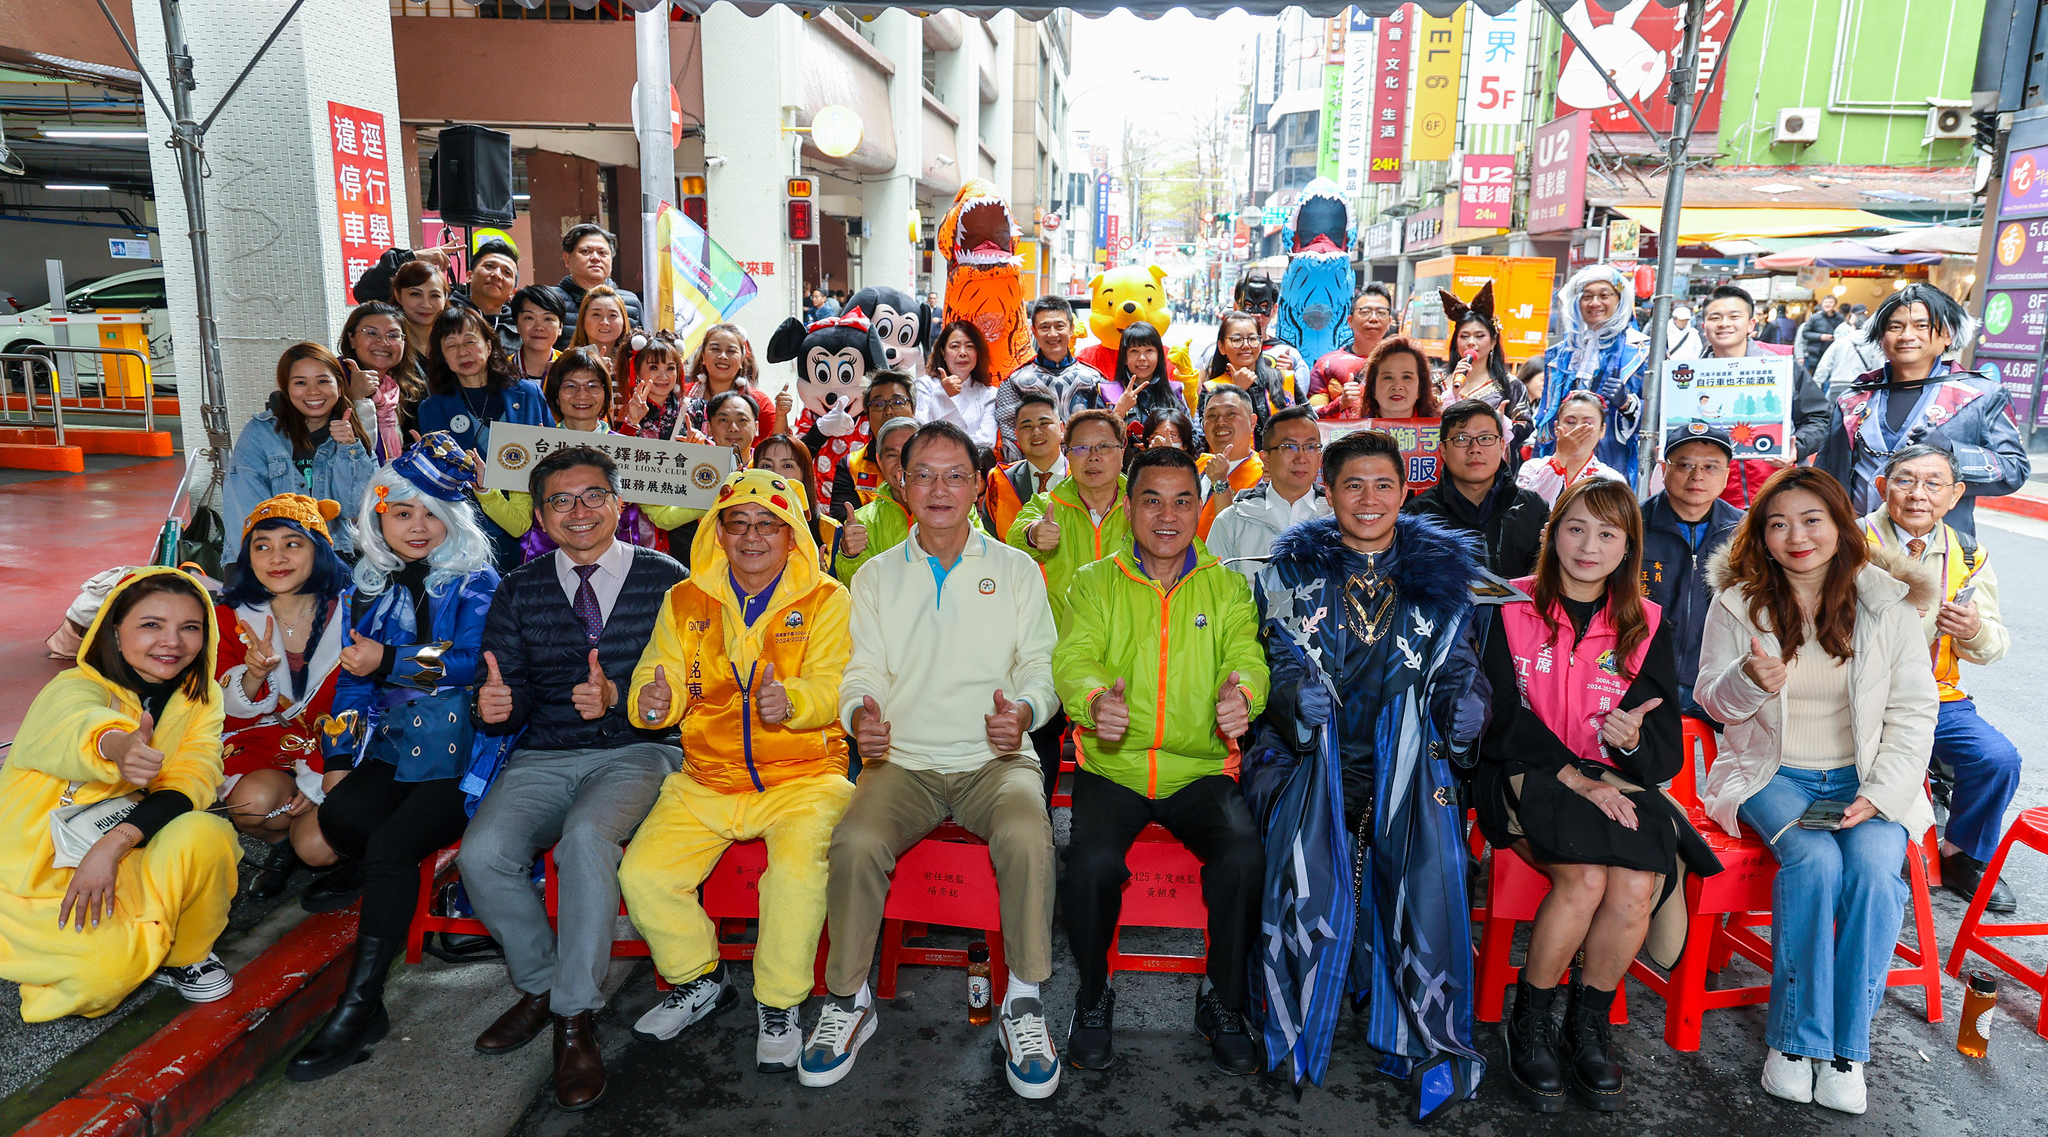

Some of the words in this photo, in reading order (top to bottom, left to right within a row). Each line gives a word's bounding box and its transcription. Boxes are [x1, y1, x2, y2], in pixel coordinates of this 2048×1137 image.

[1477, 76, 1516, 109] 5F
[1426, 120, 1440, 131] 6F
[1538, 129, 1570, 168] U2
[1372, 158, 1399, 172] 24H
[1463, 166, 1513, 184] U2
[361, 121, 391, 264] 逕行舉
[1536, 168, 1567, 201] 電影館
[1462, 185, 1511, 204] 電影館
[1474, 207, 1497, 220] 24H
[2028, 294, 2048, 309] 8F
[1697, 376, 1776, 387] 自行車也不能酒駕
[635, 465, 662, 474] LIONS
[665, 468, 687, 476] CLUB
[94, 811, 125, 831] HUANG
